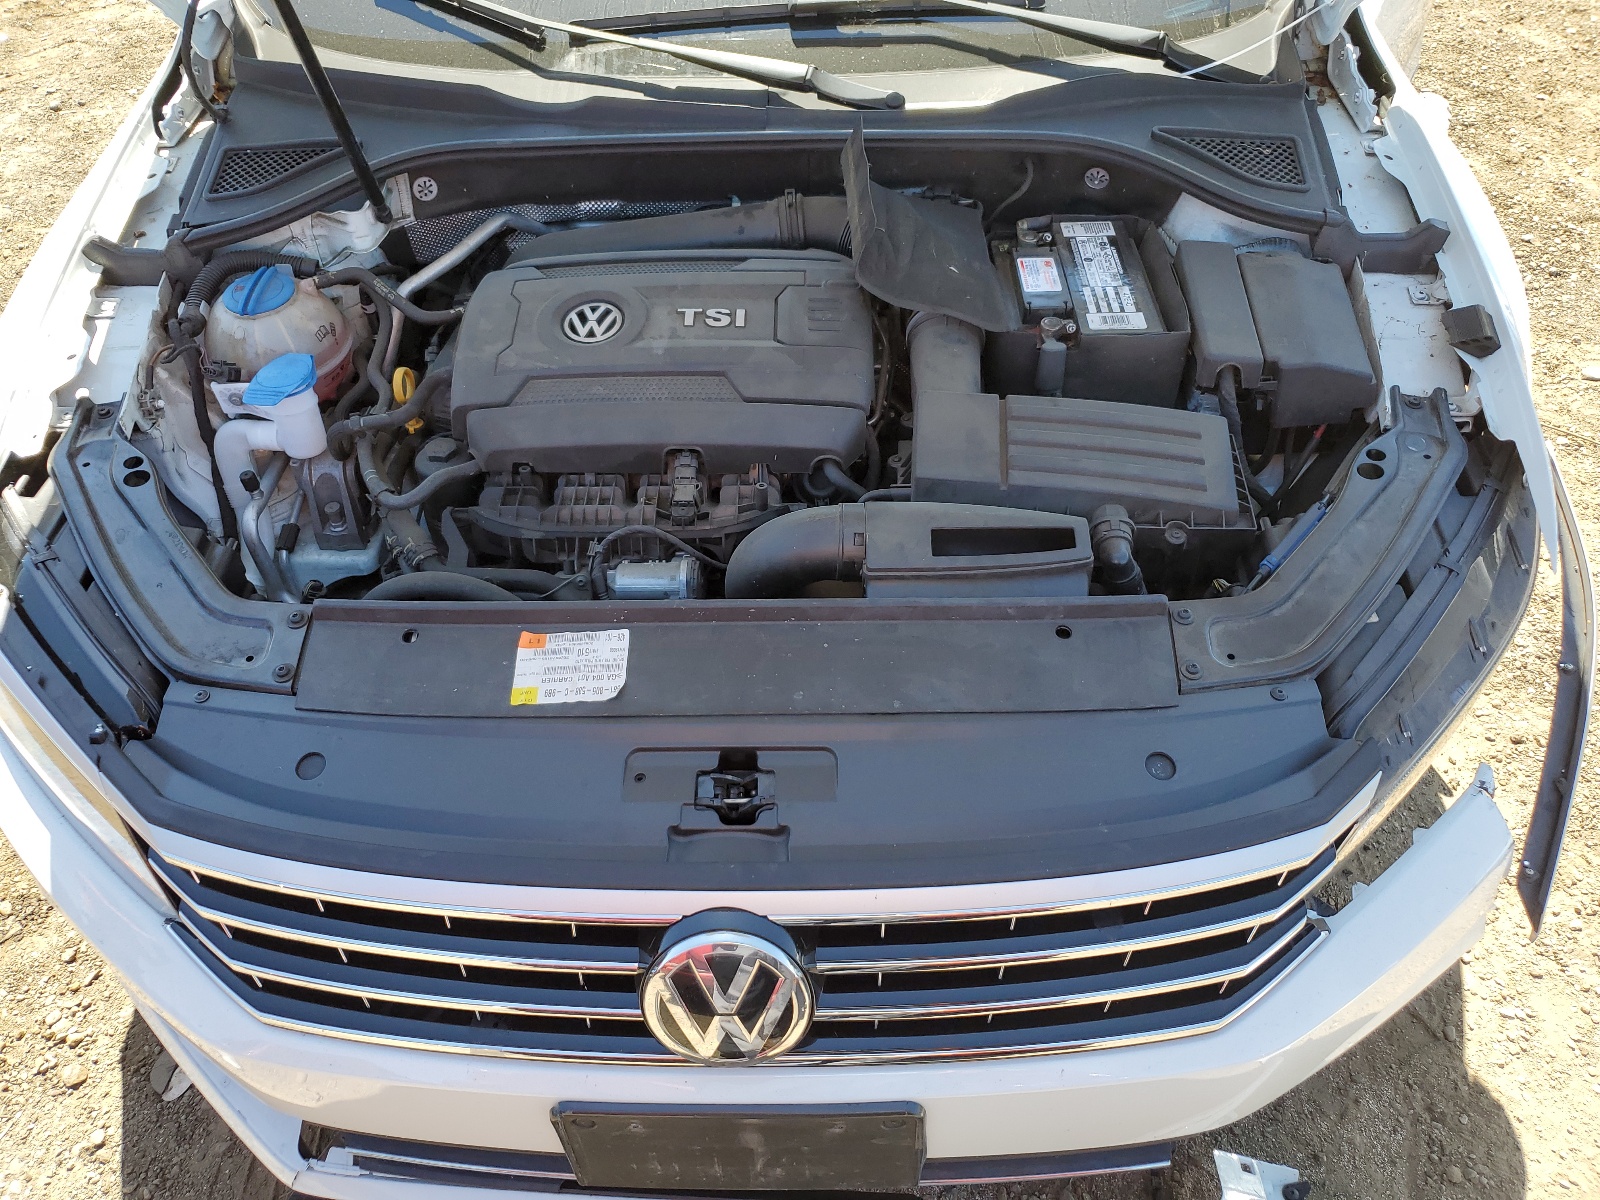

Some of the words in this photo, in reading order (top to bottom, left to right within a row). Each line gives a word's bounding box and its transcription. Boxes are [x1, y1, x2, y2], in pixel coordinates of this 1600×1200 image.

[563, 301, 624, 343] VW
[677, 308, 747, 327] TSI
[541, 676, 573, 684] CARRIER
[641, 930, 814, 1067] VW
